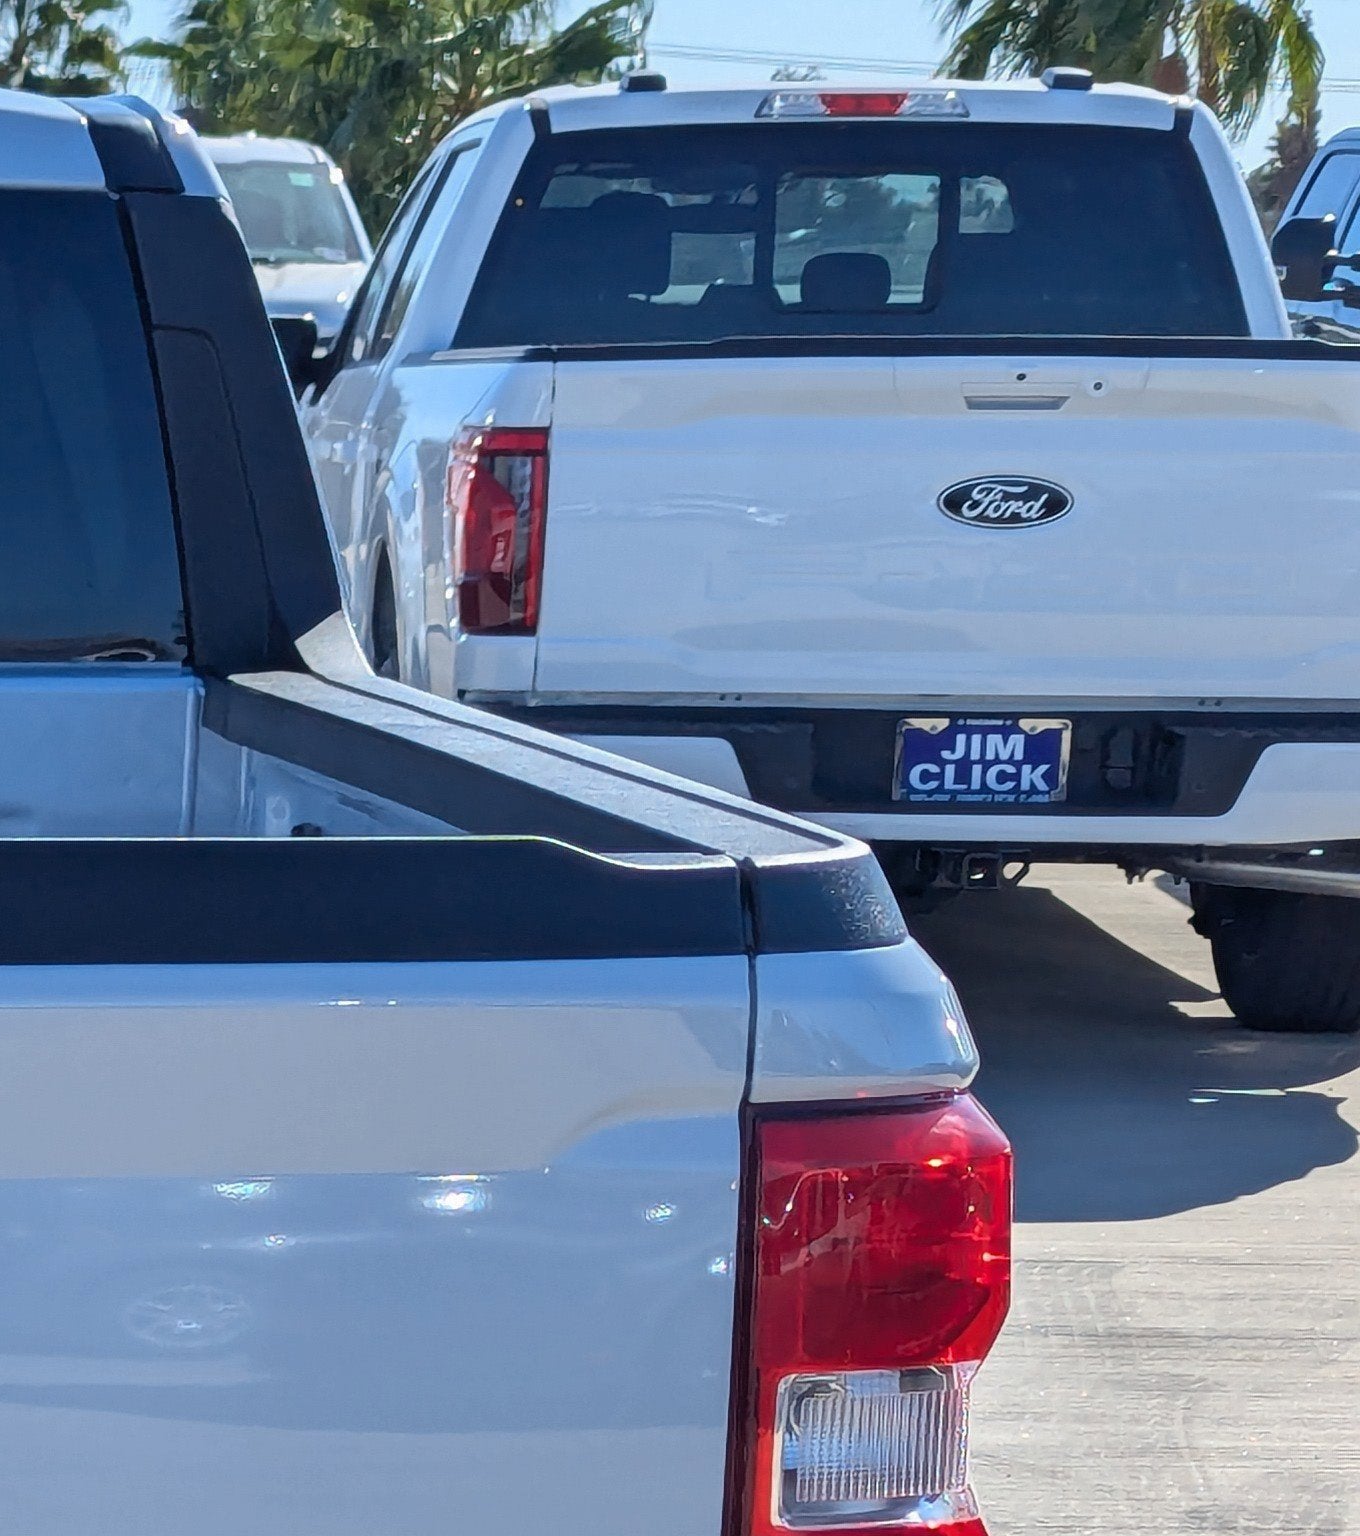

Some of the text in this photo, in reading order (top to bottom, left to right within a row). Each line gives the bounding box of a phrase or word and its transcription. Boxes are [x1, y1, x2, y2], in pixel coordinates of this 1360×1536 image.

[961, 483, 1050, 519] Ford
[940, 733, 1026, 761] JIM
[908, 763, 1052, 792] CLICK
